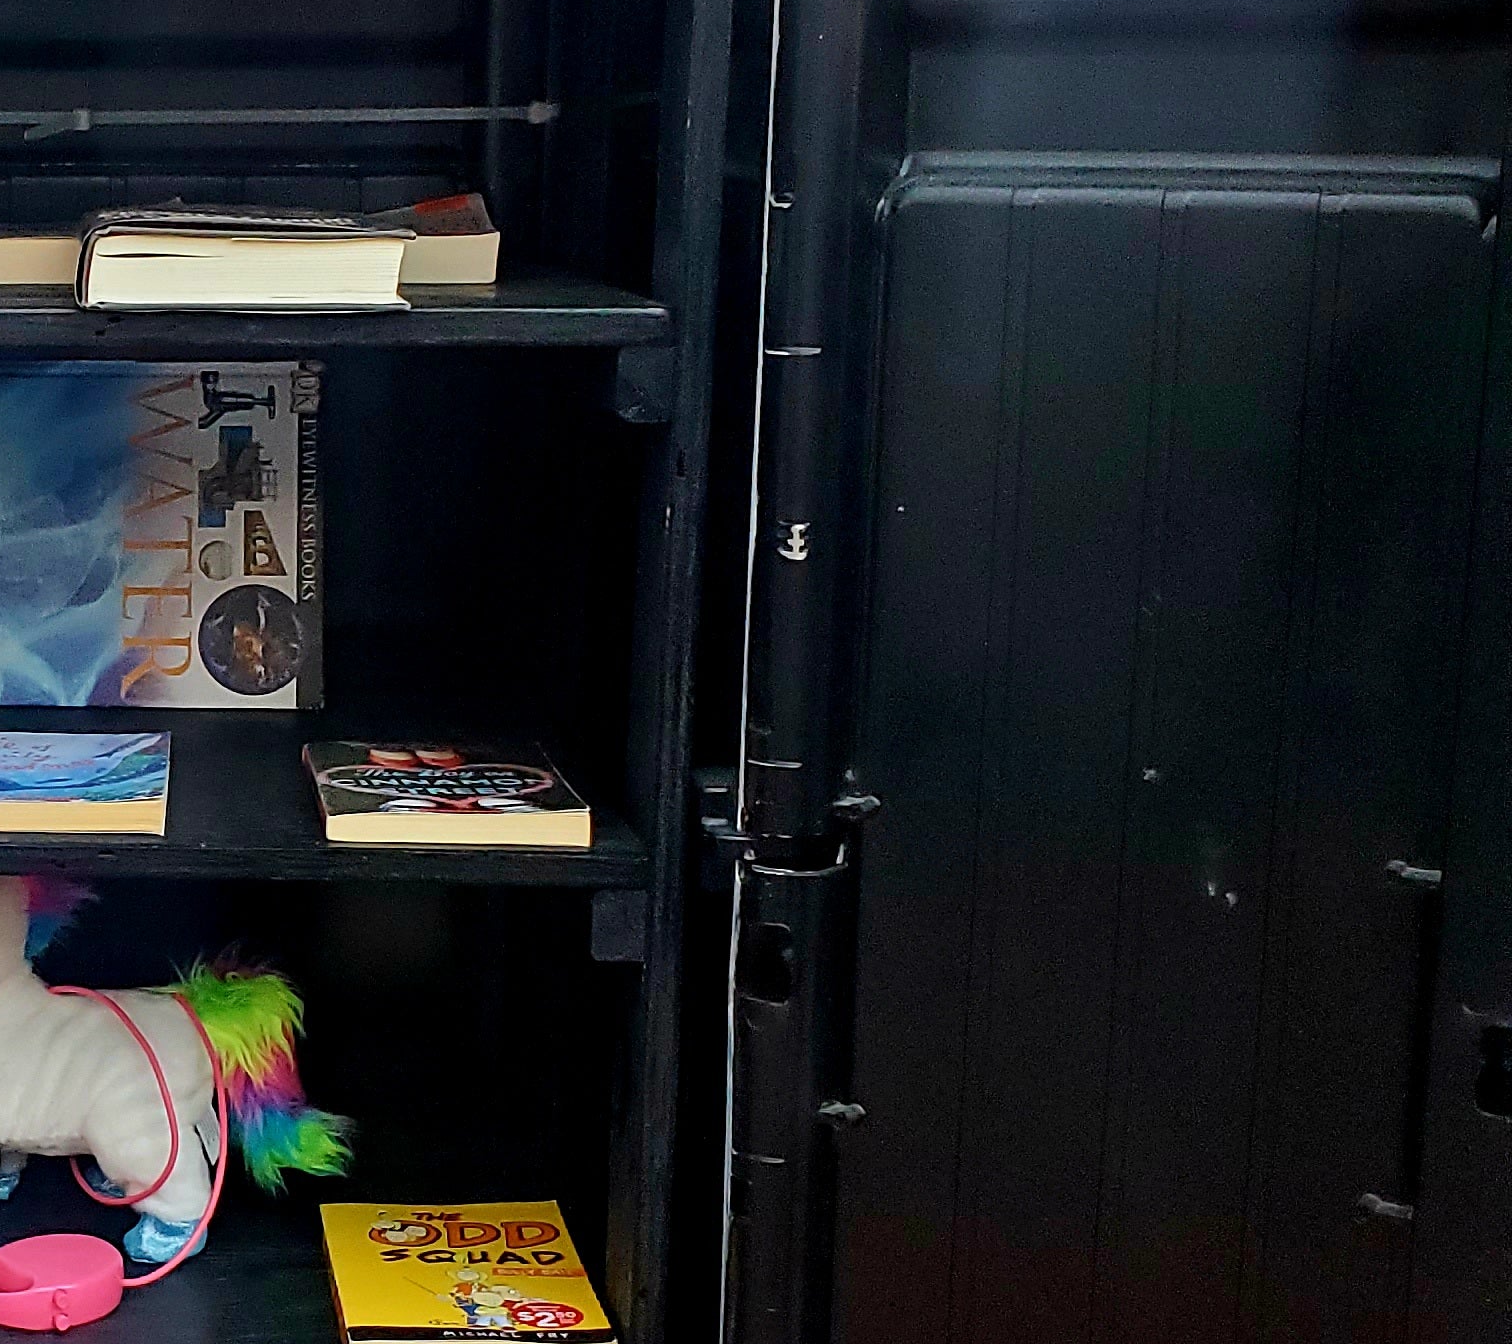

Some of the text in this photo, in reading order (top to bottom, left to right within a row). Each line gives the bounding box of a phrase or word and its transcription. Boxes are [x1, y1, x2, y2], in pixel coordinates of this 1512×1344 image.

[300, 418, 319, 602] EYEWITNESS BOOKS
[122, 374, 194, 704] WATER
[411, 1211, 464, 1221] THE
[368, 1219, 561, 1249] ODD
[379, 1248, 566, 1266] SQUAD
[442, 1330, 522, 1338] MICHAEL
